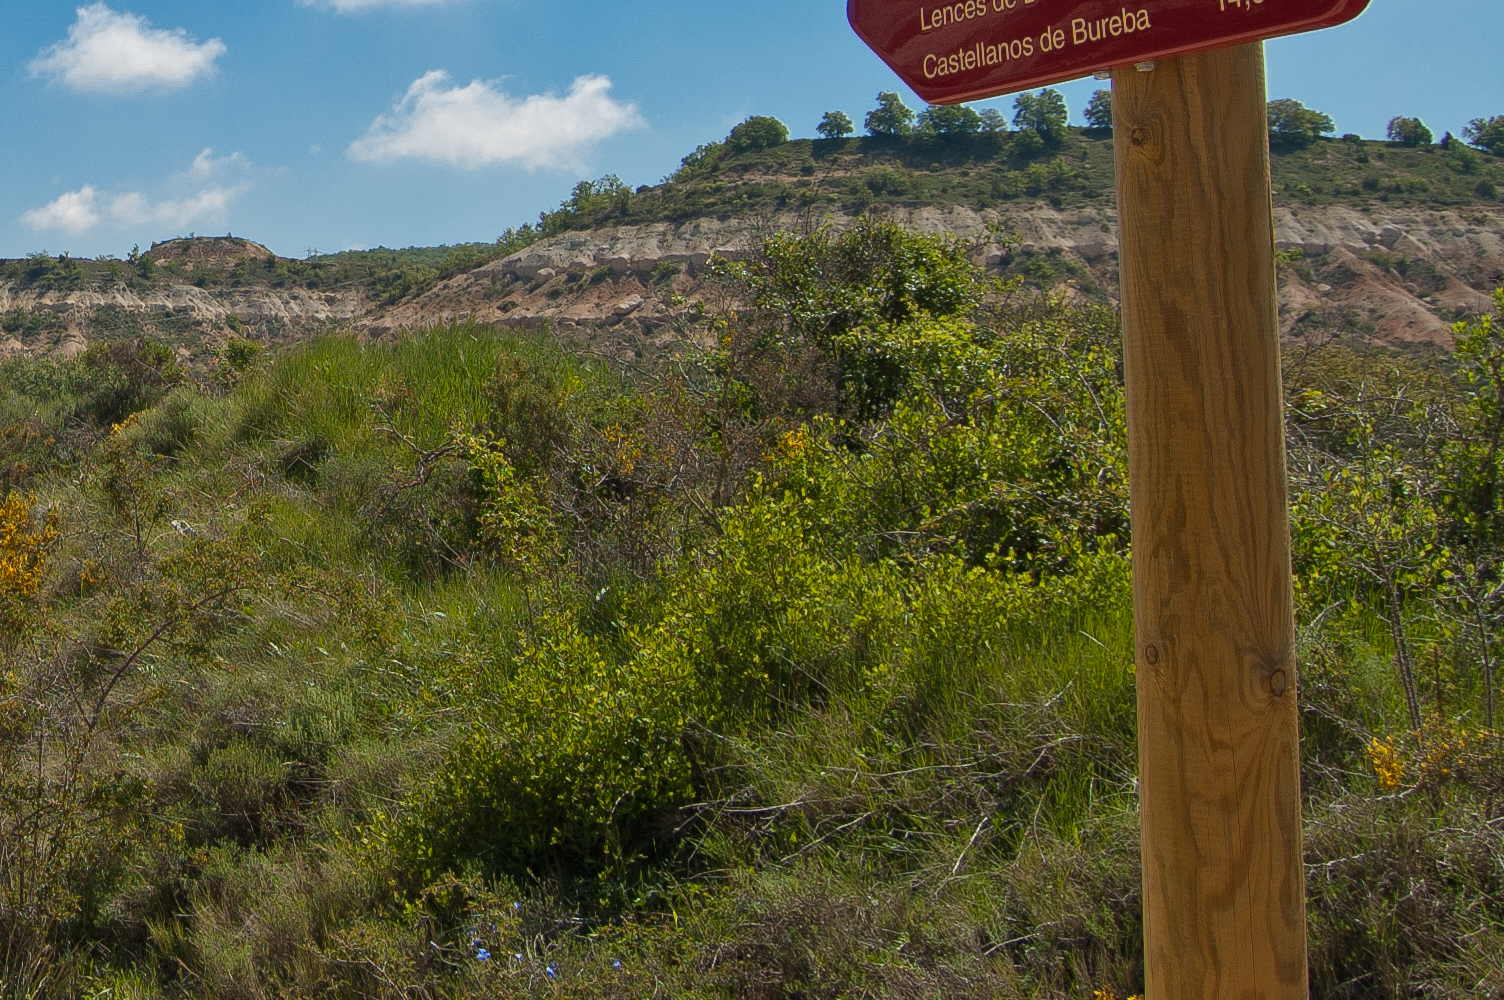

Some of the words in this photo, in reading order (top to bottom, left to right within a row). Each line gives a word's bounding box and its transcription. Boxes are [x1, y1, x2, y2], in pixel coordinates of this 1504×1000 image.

[922, 35, 1034, 79] Castellanos
[1039, 25, 1066, 53] de
[1071, 7, 1152, 45] Bureba
